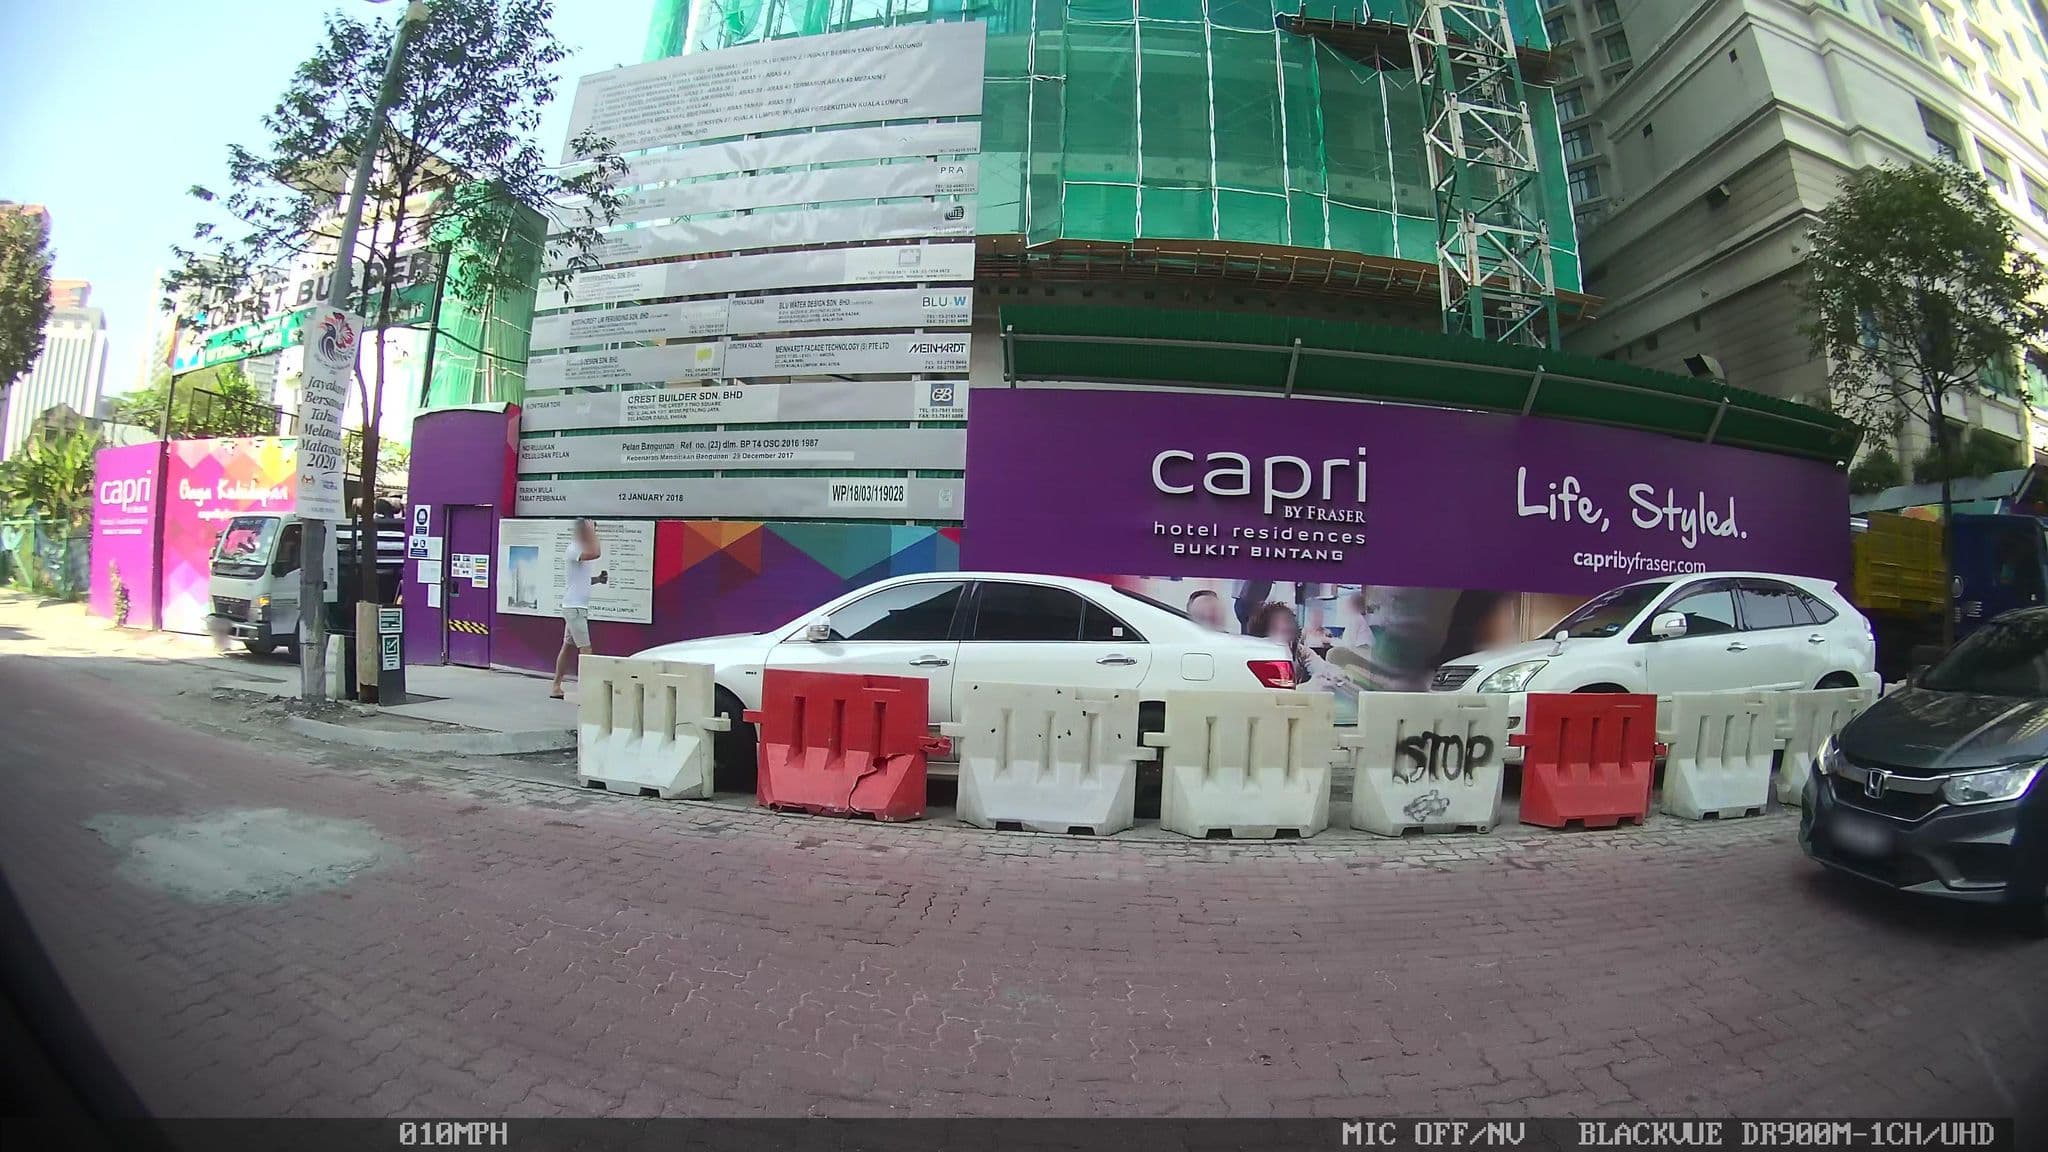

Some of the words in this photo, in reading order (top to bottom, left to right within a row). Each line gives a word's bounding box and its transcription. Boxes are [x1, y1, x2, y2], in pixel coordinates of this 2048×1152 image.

[940, 166, 964, 174] PRA
[922, 296, 947, 307] BLU
[775, 344, 804, 353] MEINHARDT
[804, 343, 824, 352] FACADE
[824, 342, 859, 352] TECHNOLOGY
[868, 342, 879, 350] PTE
[880, 341, 890, 350] LTD
[909, 343, 966, 353] MEINHARDT
[628, 393, 656, 404] CREST
[659, 392, 697, 403] BUILDER
[723, 390, 743, 400] BHD
[622, 442, 640, 451] Pelan
[641, 442, 675, 452] Bangunan
[708, 441, 721, 450] (23)
[722, 440, 738, 449] dlm.
[740, 440, 751, 448] BP
[763, 439, 780, 448] OSC
[781, 439, 799, 448] 2016
[802, 438, 819, 447] 1987
[307, 453, 337, 470] 2020
[552, 451, 570, 459] PELAN
[778, 451, 794, 459] 2017
[1152, 446, 1367, 514] capri
[101, 469, 152, 513] capri
[618, 493, 626, 501] 12
[627, 493, 664, 502] JANUARY
[666, 494, 683, 502] 2018
[832, 484, 904, 502] WP/18/03/119028
[1284, 505, 1303, 519] BY
[1307, 505, 1367, 524] FRASER
[1517, 466, 1610, 533] Life,
[1628, 483, 1748, 549] Styled.
[1154, 521, 1218, 537] hotel
[1233, 526, 1366, 545] residences
[1174, 543, 1240, 556] BUKIT
[1251, 547, 1344, 561] BINTANG
[1573, 550, 1706, 575] capribyfraser.com
[1394, 730, 1494, 784] STOP
